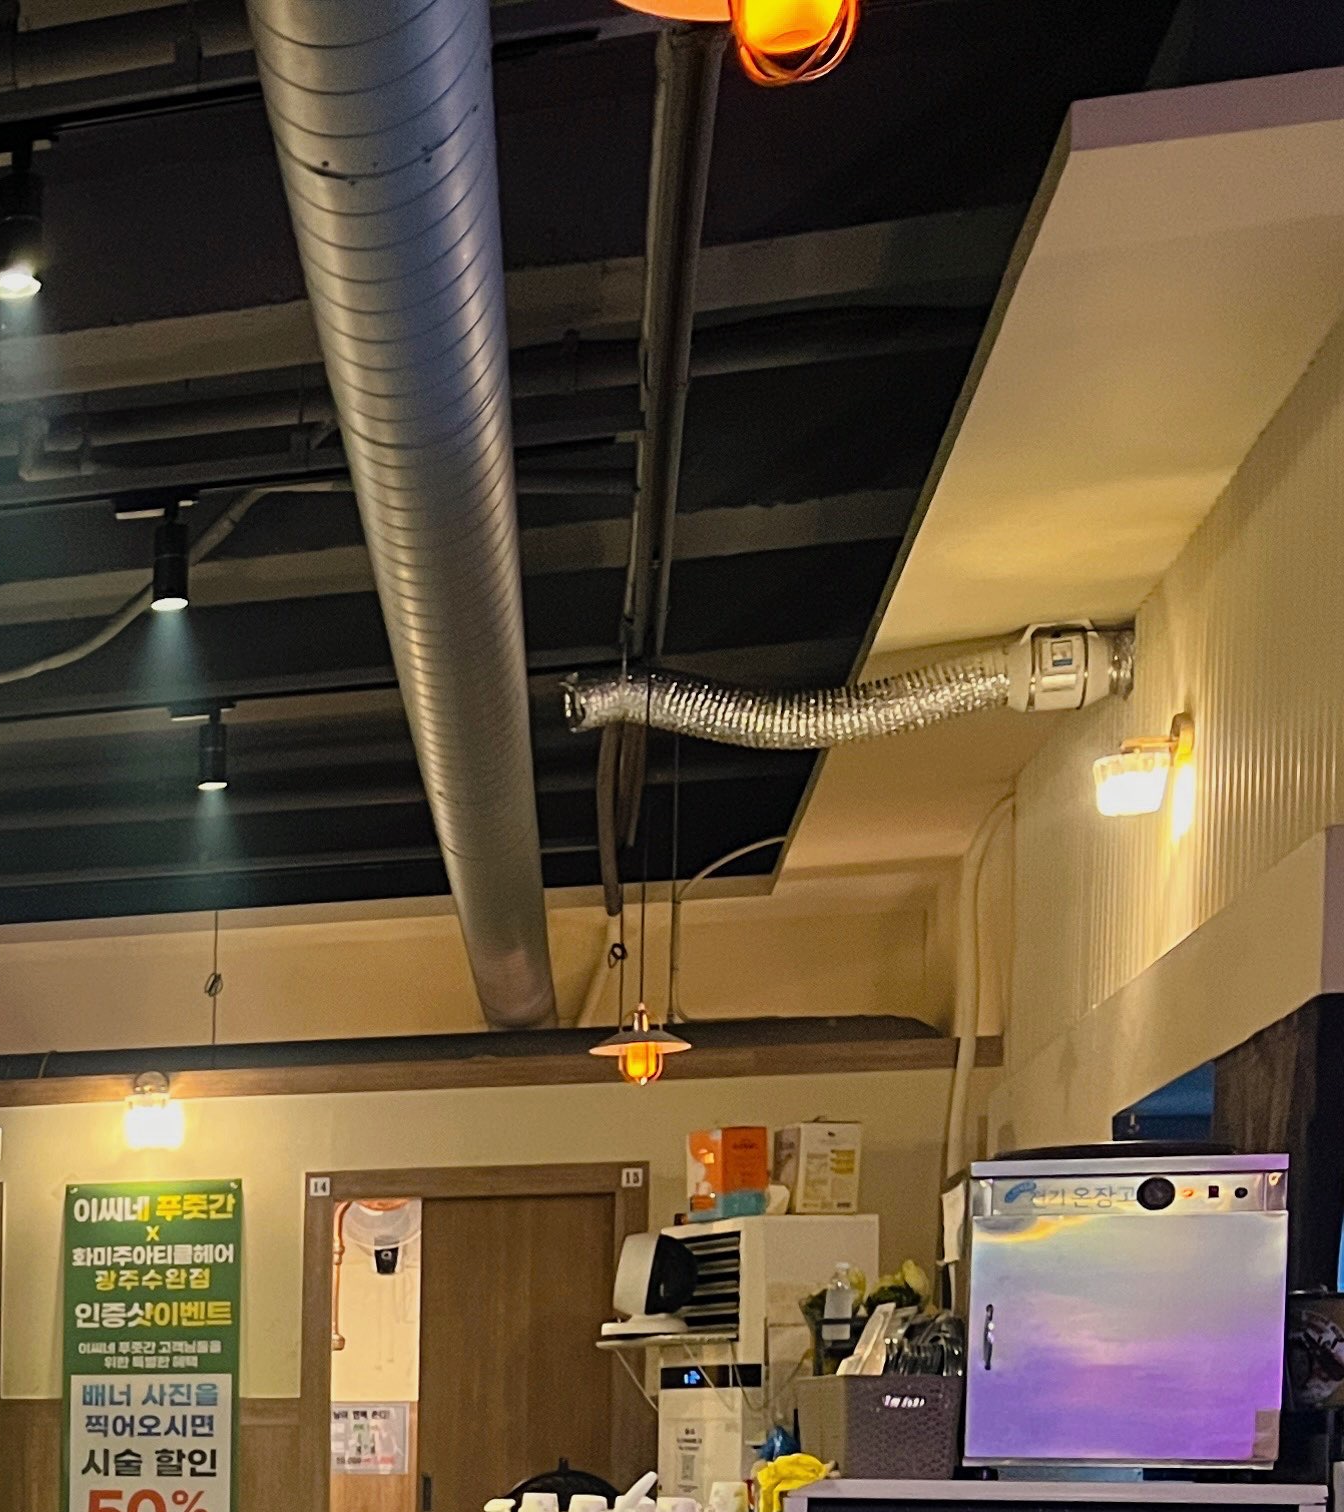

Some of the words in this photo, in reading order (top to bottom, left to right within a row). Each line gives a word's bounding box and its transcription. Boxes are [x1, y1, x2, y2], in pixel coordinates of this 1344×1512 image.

[73, 1196, 151, 1223] 이씨네
[156, 1193, 236, 1221] 푸줏간
[1073, 1186, 1136, 1208] 온장고
[95, 1268, 211, 1291] 광주수완점
[82, 1384, 131, 1407] 배너
[141, 1383, 218, 1407] 사진을
[85, 1414, 215, 1438] 찍어오시면
[81, 1449, 143, 1477] 시술
[154, 1448, 217, 1478] 할인
